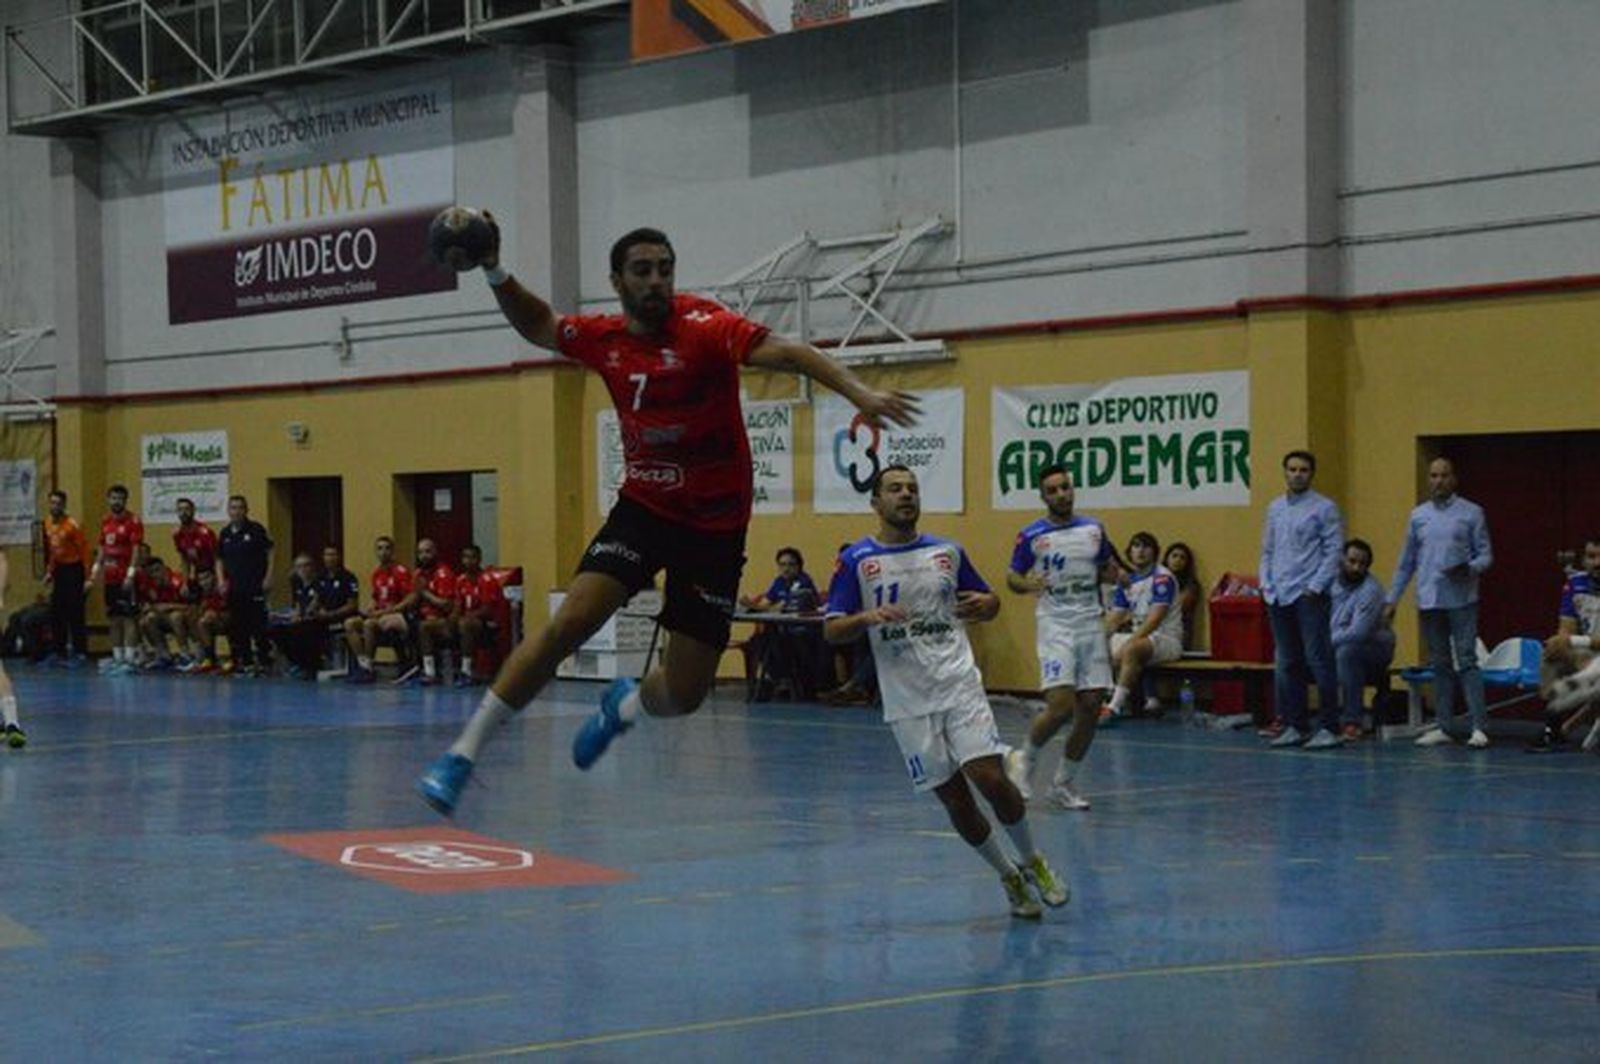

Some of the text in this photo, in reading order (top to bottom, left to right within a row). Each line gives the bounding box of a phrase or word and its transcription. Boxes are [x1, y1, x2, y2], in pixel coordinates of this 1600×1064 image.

[352, 91, 440, 132] MUNICIPAL
[217, 152, 388, 231] FÁTIMA
[266, 227, 377, 283] IMDECO
[628, 373, 648, 411] 7
[1027, 392, 1218, 428] CLUB DEPORTIVO
[752, 433, 785, 456] TIVA
[1043, 552, 1065, 571] 14
[873, 582, 899, 606] 11
